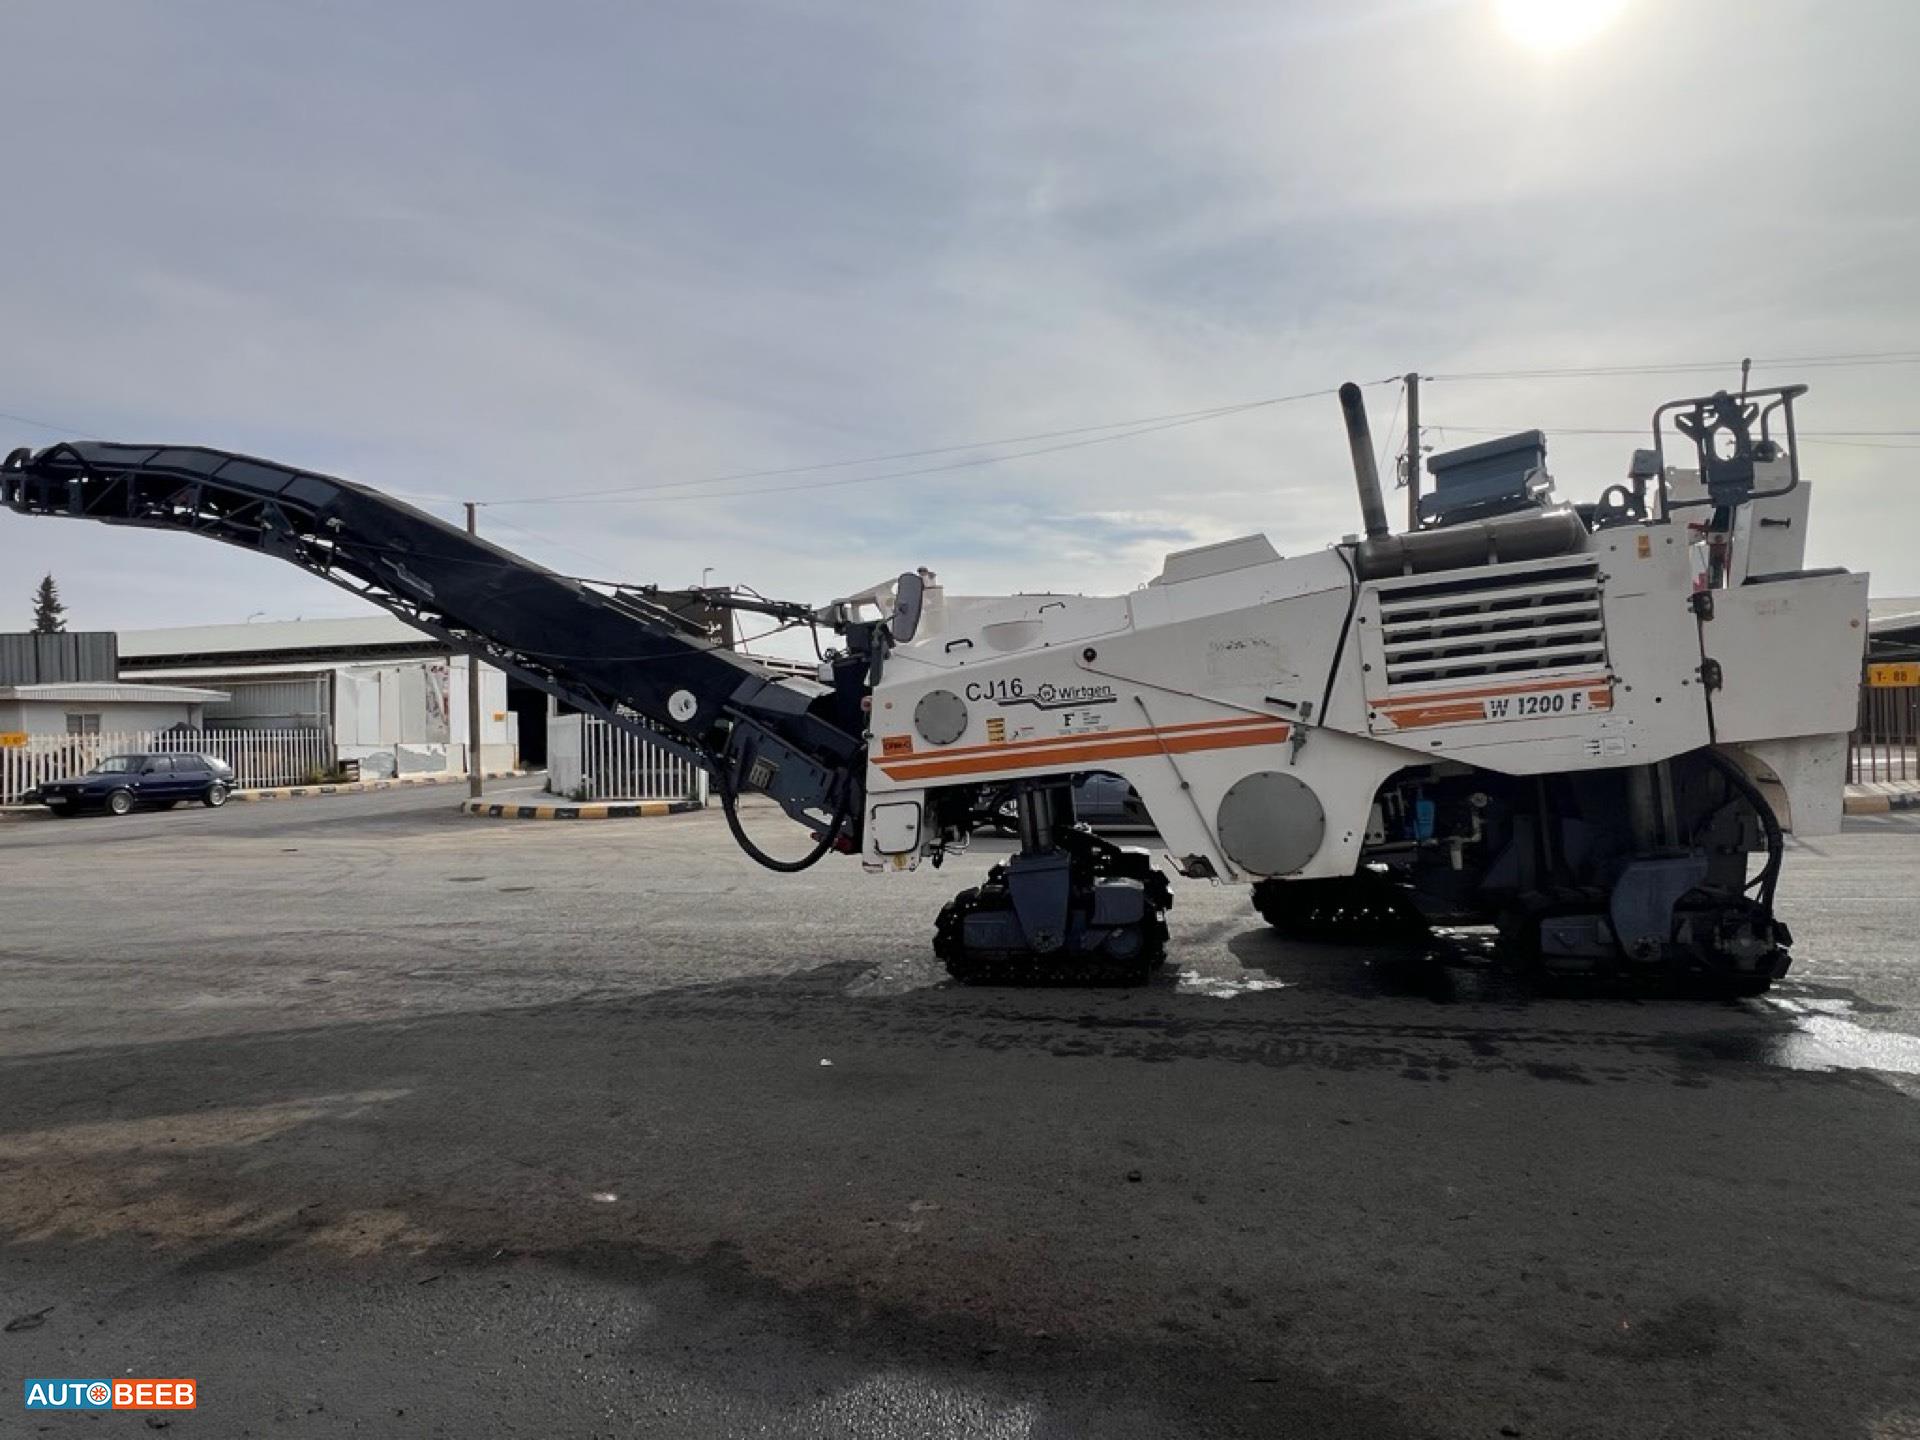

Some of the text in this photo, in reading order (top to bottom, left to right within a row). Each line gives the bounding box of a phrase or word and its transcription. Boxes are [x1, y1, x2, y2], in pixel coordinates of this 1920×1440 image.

[966, 678, 1023, 701] CJ16
[1058, 683, 1112, 699] Wirtgen
[1490, 692, 1582, 717] W 1200 F
